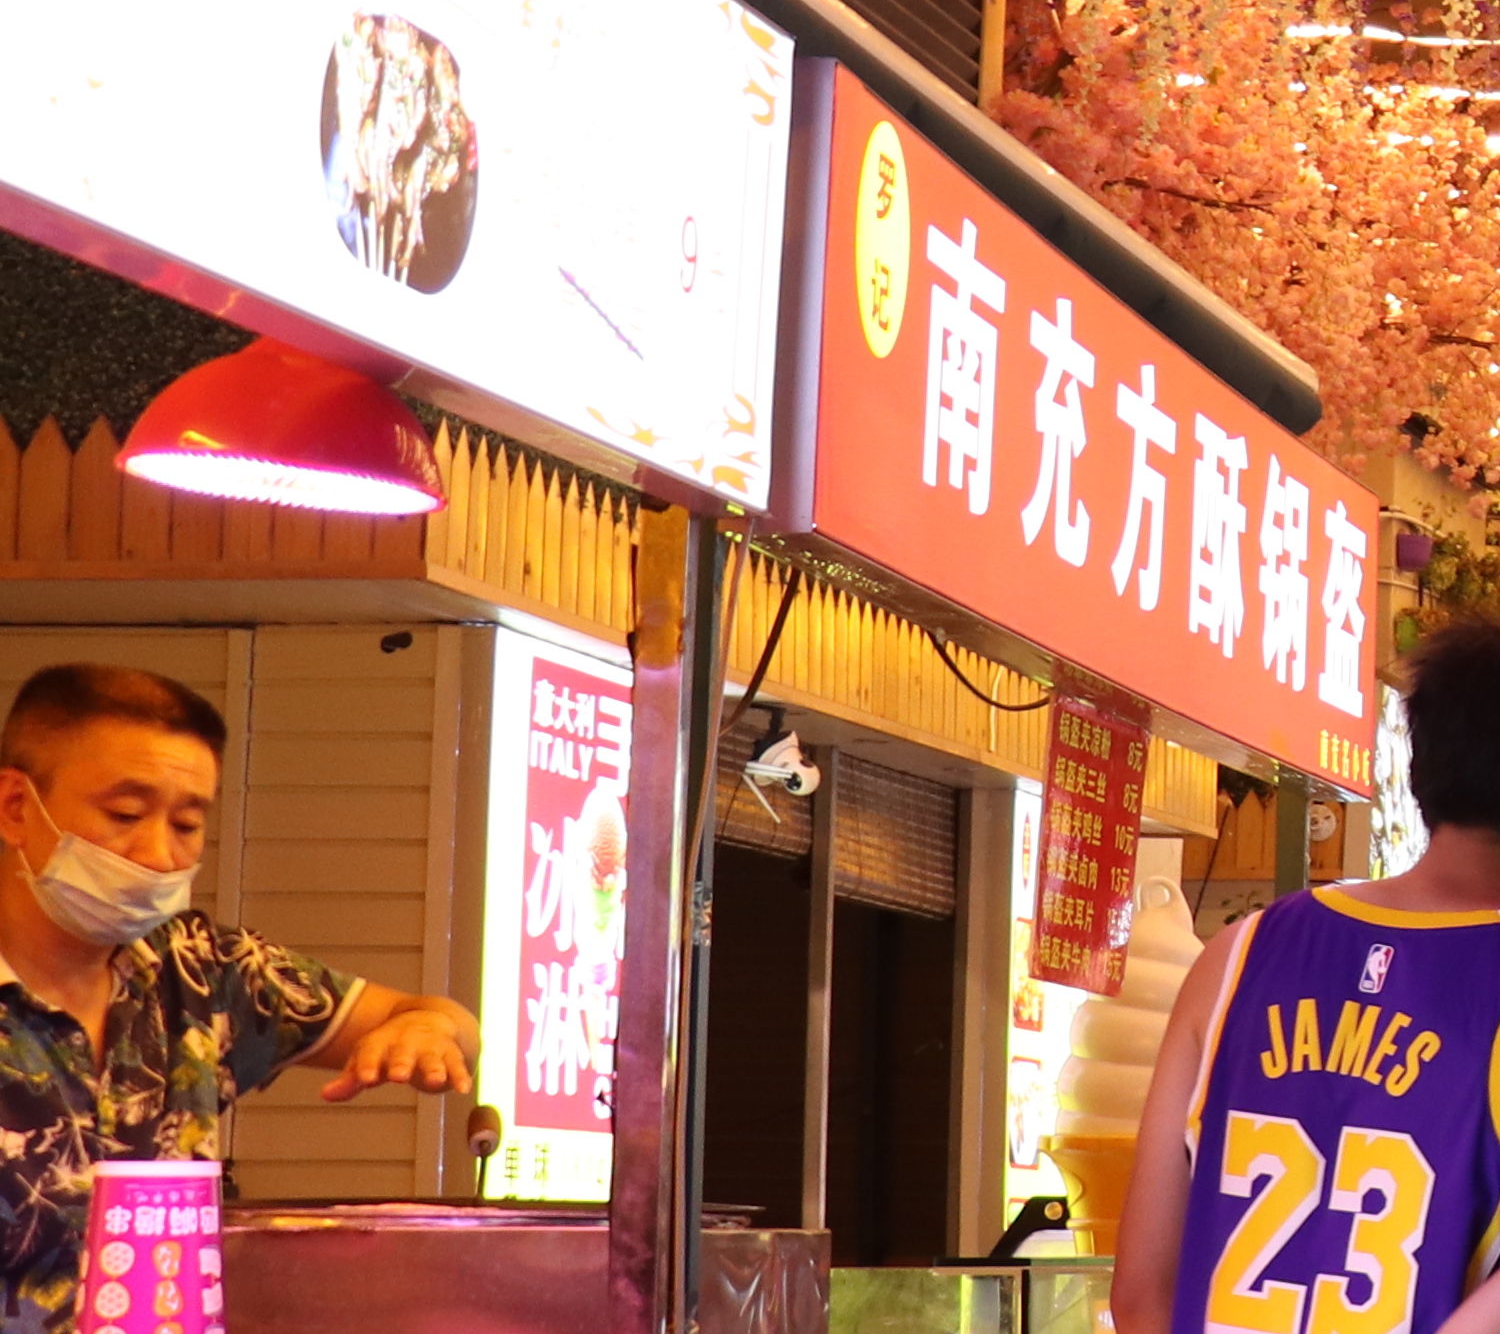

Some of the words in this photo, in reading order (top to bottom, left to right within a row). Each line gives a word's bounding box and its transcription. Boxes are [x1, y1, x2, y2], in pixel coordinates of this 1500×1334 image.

[868, 158, 897, 332] 罗记
[921, 217, 1369, 718] 南充方酥锅盔
[529, 730, 595, 783] ITALY
[532, 678, 596, 741] 意大利
[1260, 997, 1442, 1098] JAMES
